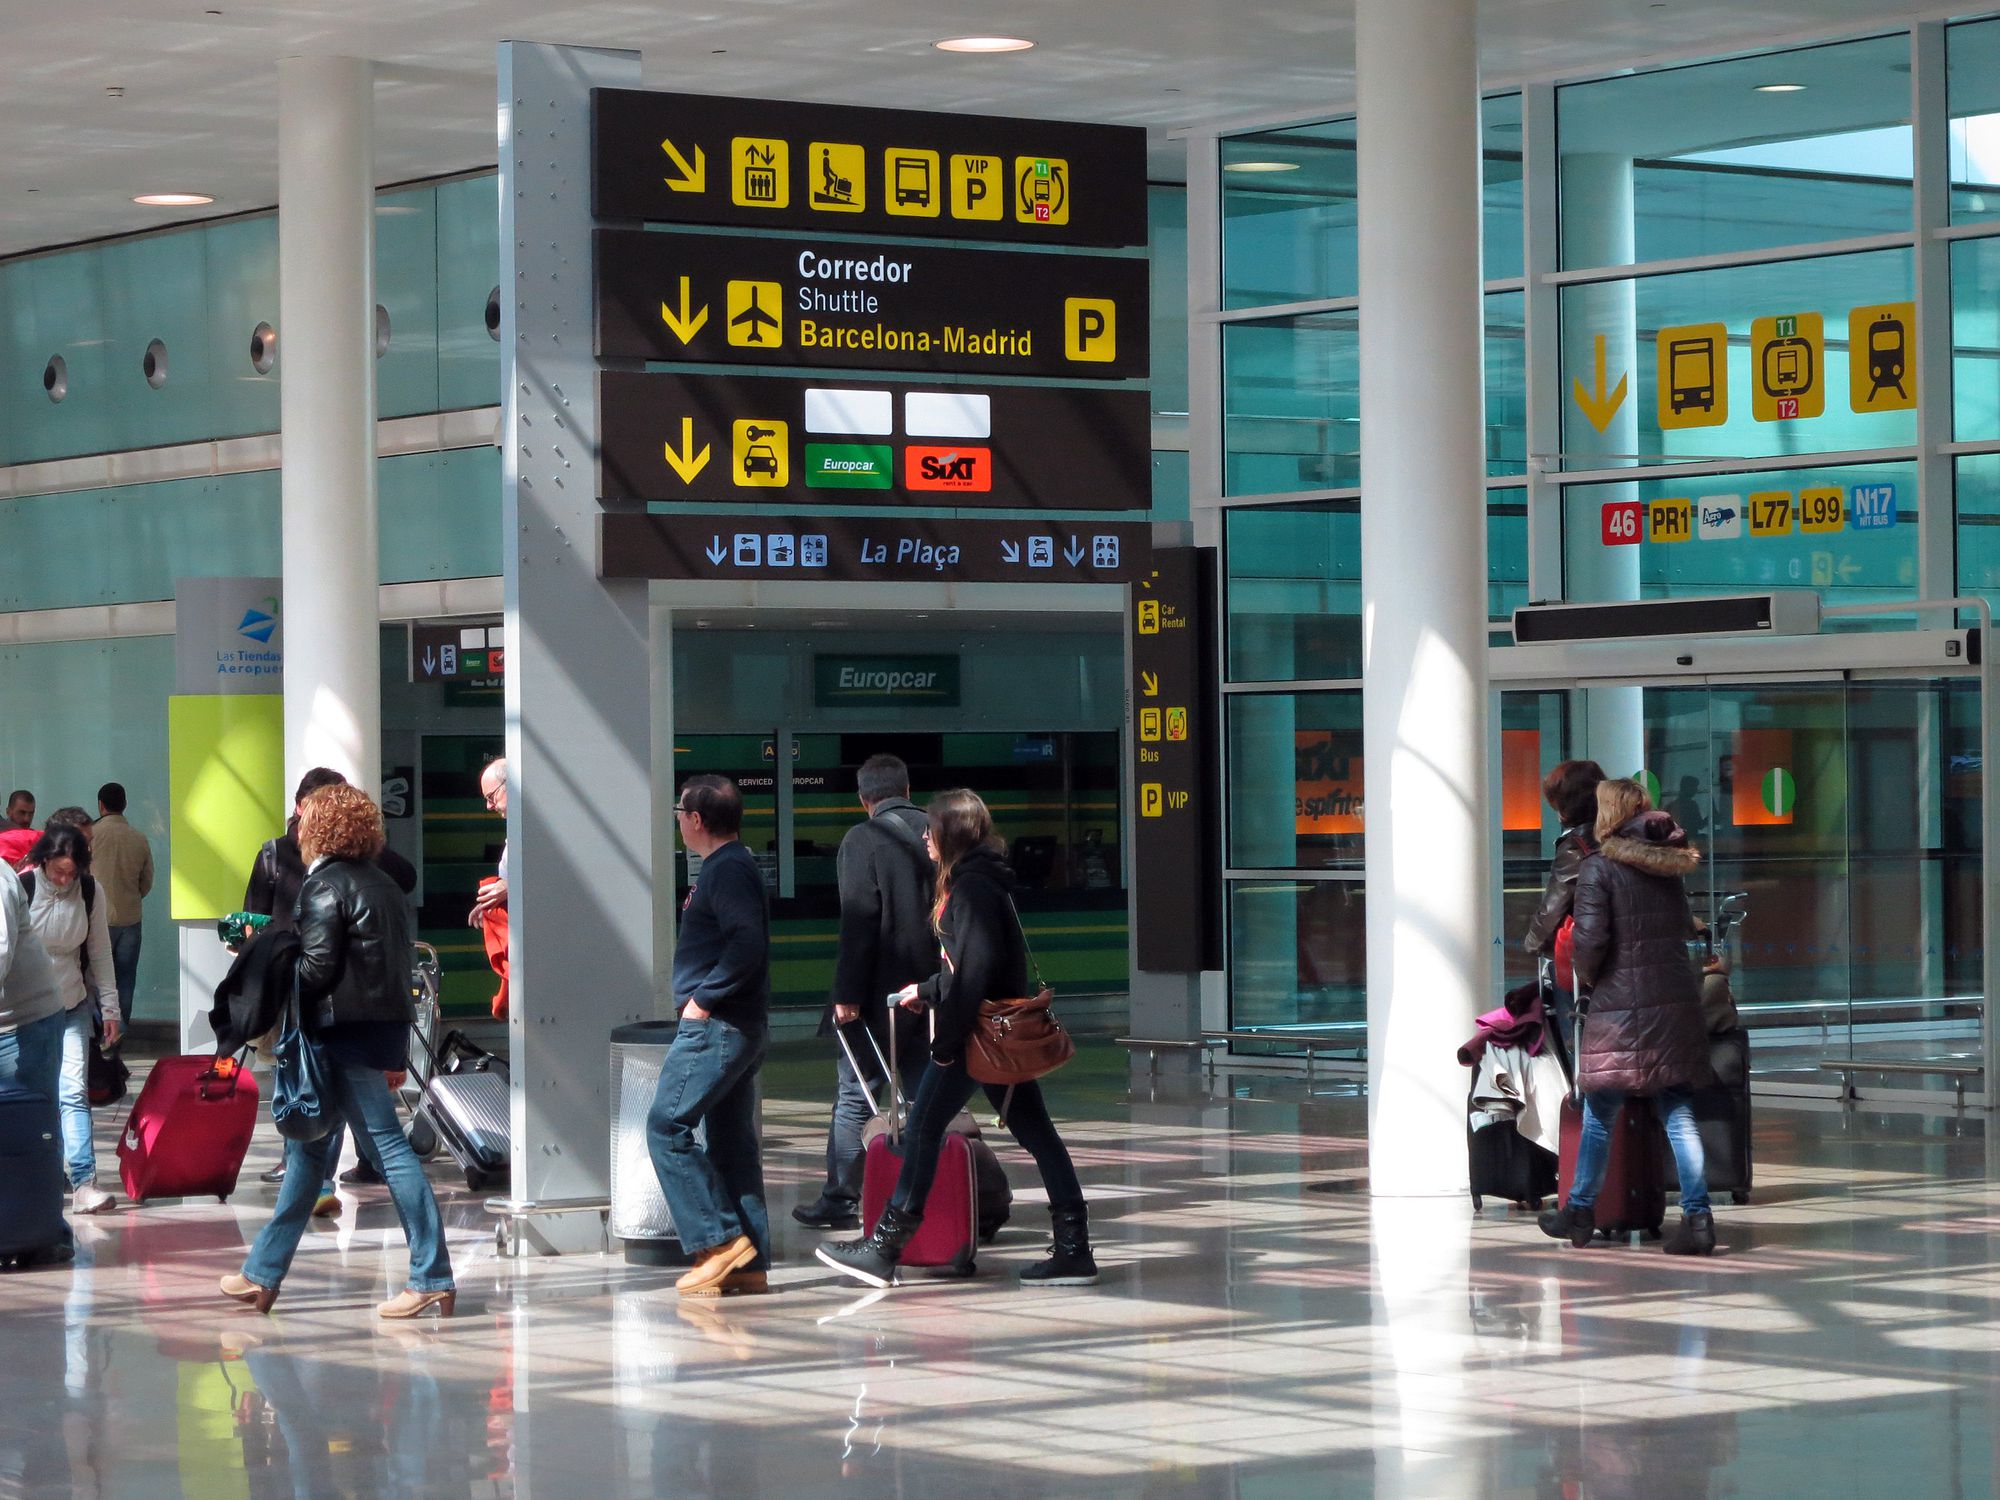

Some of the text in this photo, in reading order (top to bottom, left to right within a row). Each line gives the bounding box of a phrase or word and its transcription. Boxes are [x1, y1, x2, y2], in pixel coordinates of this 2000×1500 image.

[964, 159, 988, 174] VIP
[1035, 162, 1048, 175] T1
[966, 178, 987, 210] P
[1036, 206, 1049, 218] T2
[798, 250, 912, 283] Corredor
[798, 287, 879, 314] Shuttle
[800, 319, 1032, 356] Barcelona-Madrid
[1078, 308, 1105, 352] P
[1777, 318, 1795, 336] T1
[1778, 399, 1797, 418] T2
[823, 458, 875, 473] Europcar
[1802, 496, 1840, 525] L99
[1855, 488, 1892, 516] N17
[1609, 509, 1636, 537] 46
[1652, 507, 1688, 535] PR1
[1752, 500, 1789, 529] L77
[1873, 515, 1889, 526] BUS
[860, 538, 961, 571] La Plaça
[1161, 604, 1176, 616] Car
[1161, 616, 1186, 629] Rental
[216, 650, 282, 661] Las Tiendas
[839, 666, 937, 694] Europcar
[1140, 748, 1160, 762] Bus
[738, 777, 825, 786] SERVICED ROPCAR
[1146, 789, 1190, 812] P VIP
